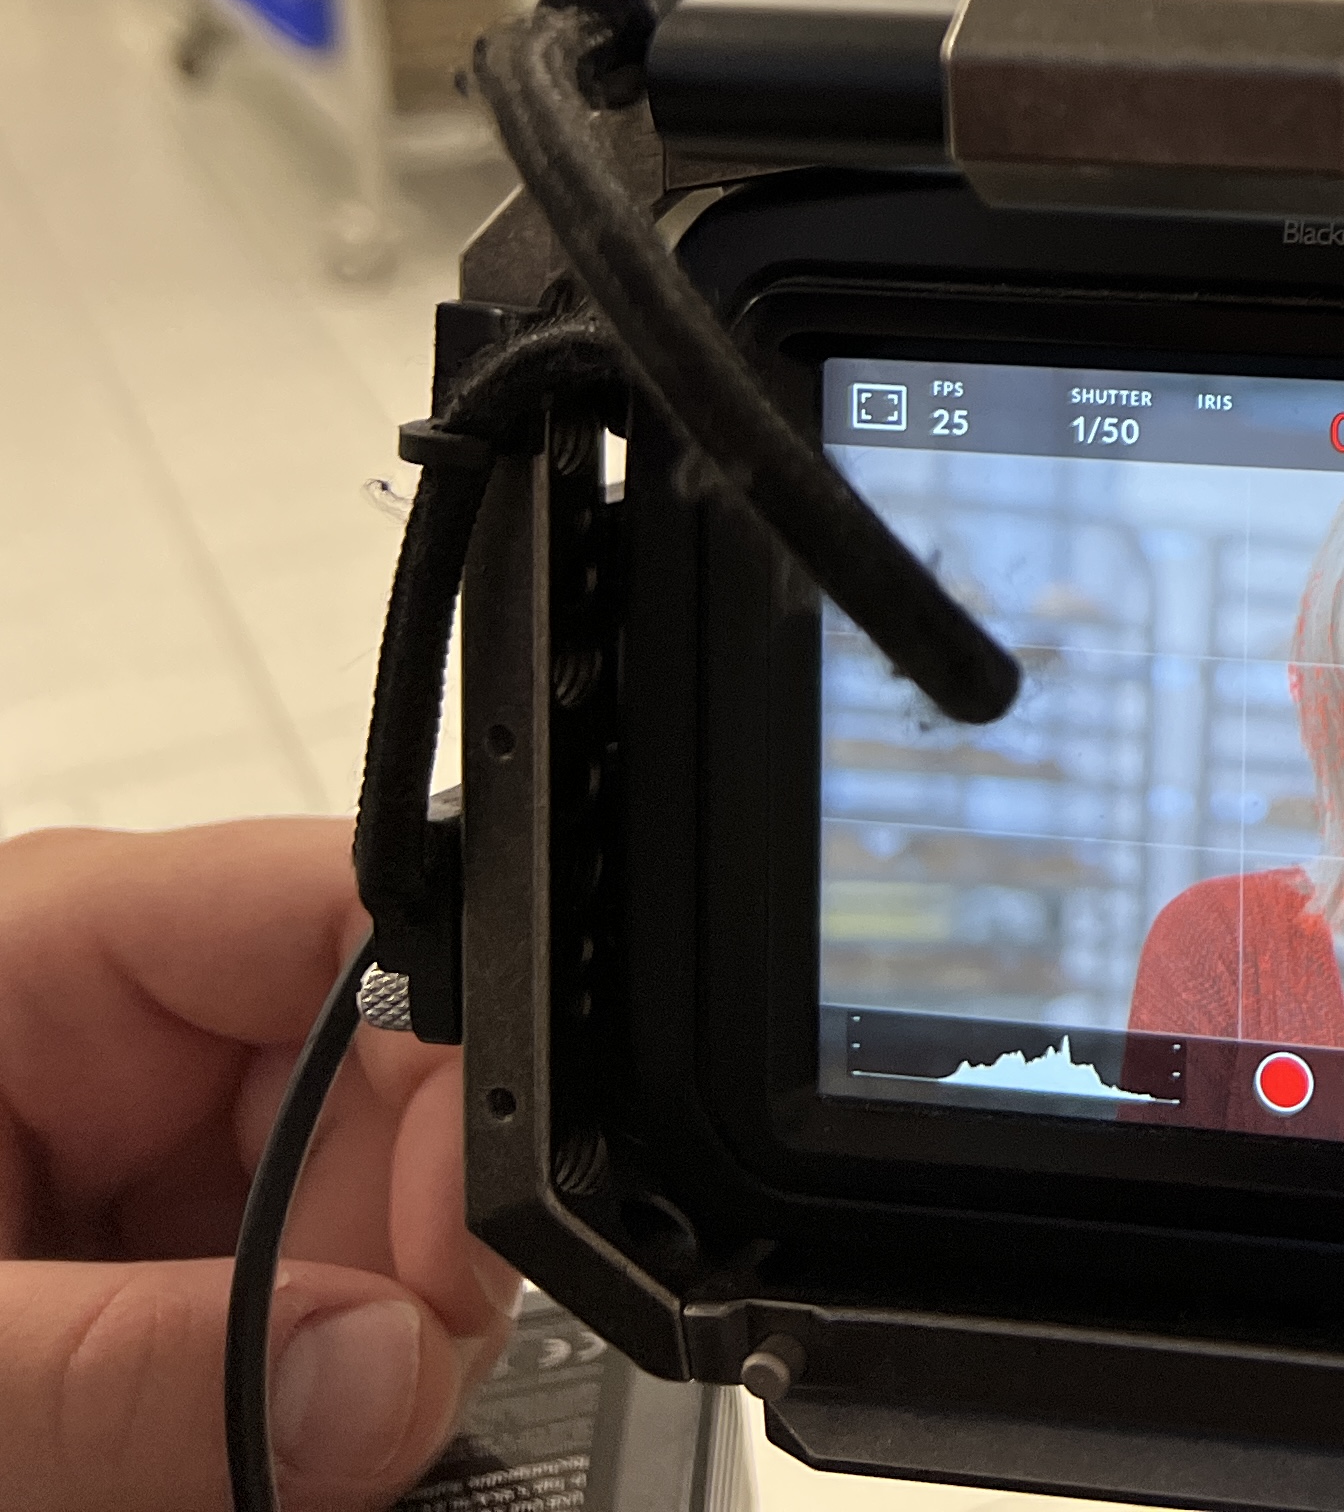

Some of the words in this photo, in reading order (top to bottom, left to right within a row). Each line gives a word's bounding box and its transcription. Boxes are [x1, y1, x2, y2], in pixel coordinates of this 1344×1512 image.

[932, 380, 964, 398] FPS
[1070, 388, 1153, 408] SHUTTER
[1196, 393, 1233, 412] IRIS
[931, 409, 969, 438] 25
[1070, 415, 1141, 445] 1/50
